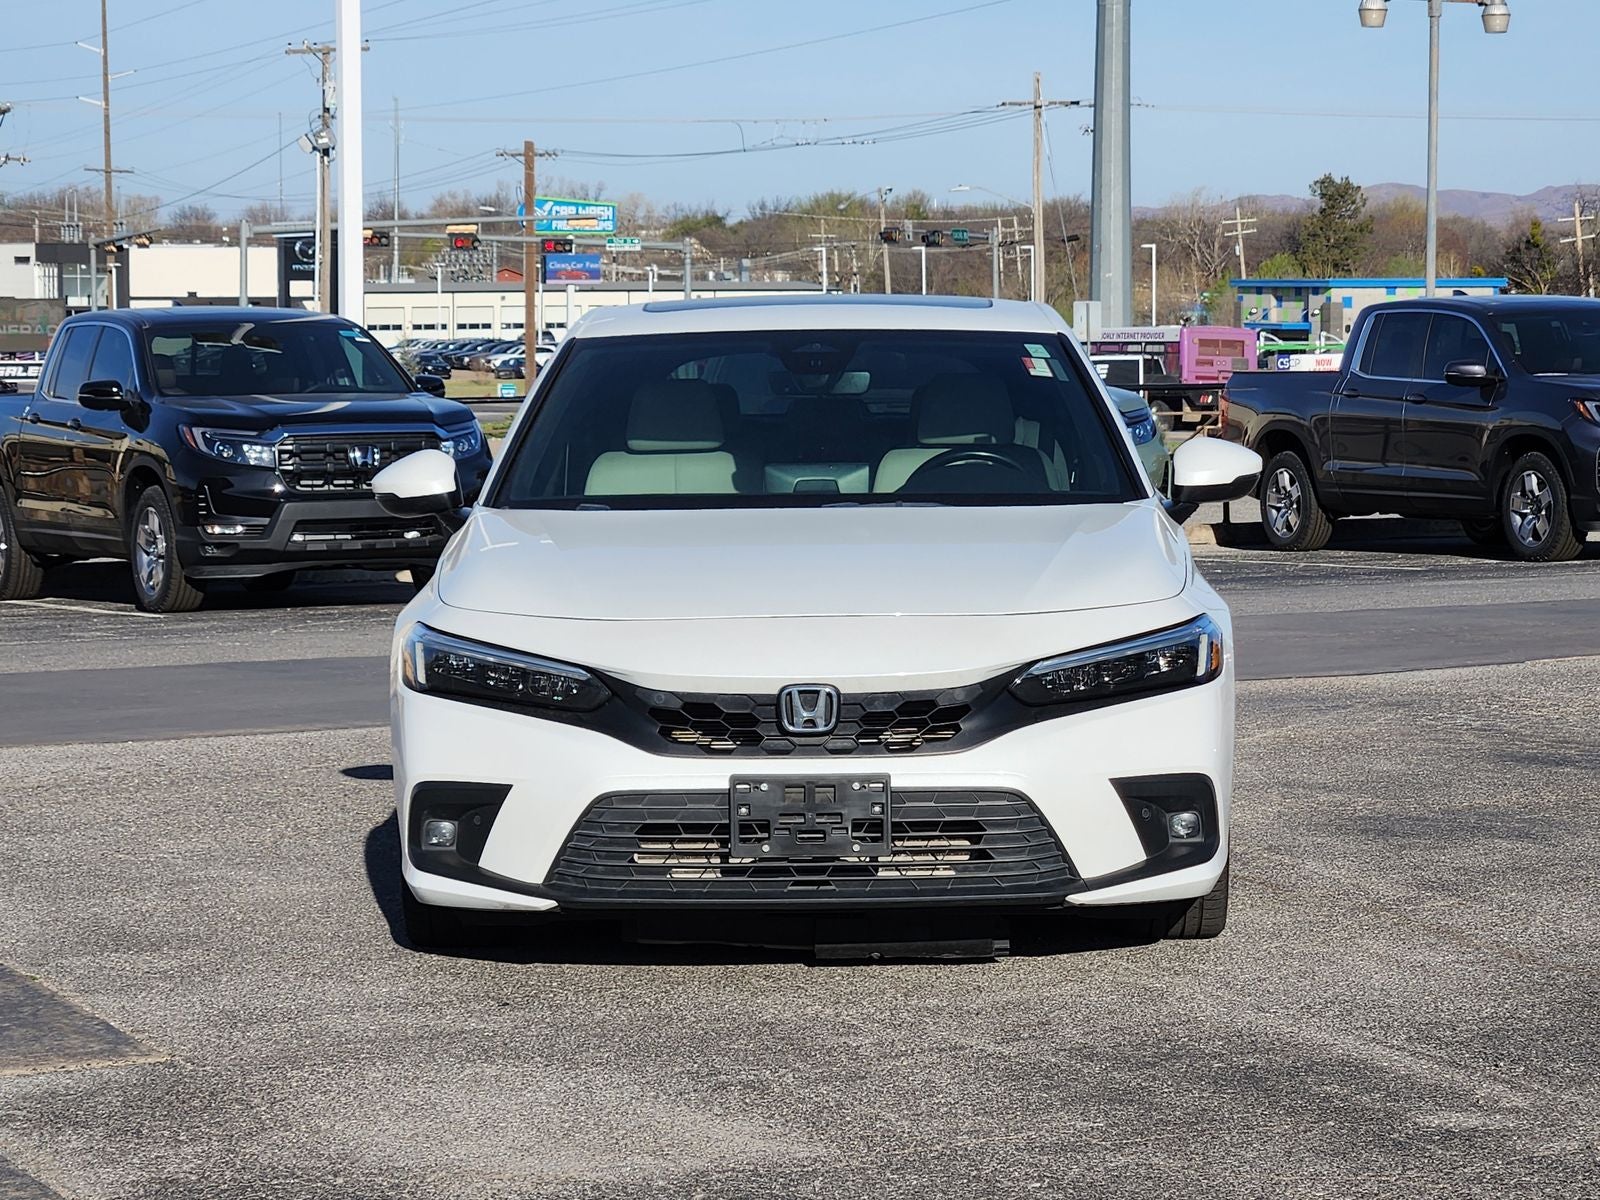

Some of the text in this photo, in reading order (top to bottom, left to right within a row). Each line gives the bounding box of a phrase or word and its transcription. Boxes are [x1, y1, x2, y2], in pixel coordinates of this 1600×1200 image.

[1117, 332, 1140, 340] INTERNET
[1140, 332, 1165, 340] PROVIDER
[1315, 358, 1332, 367] NOW
